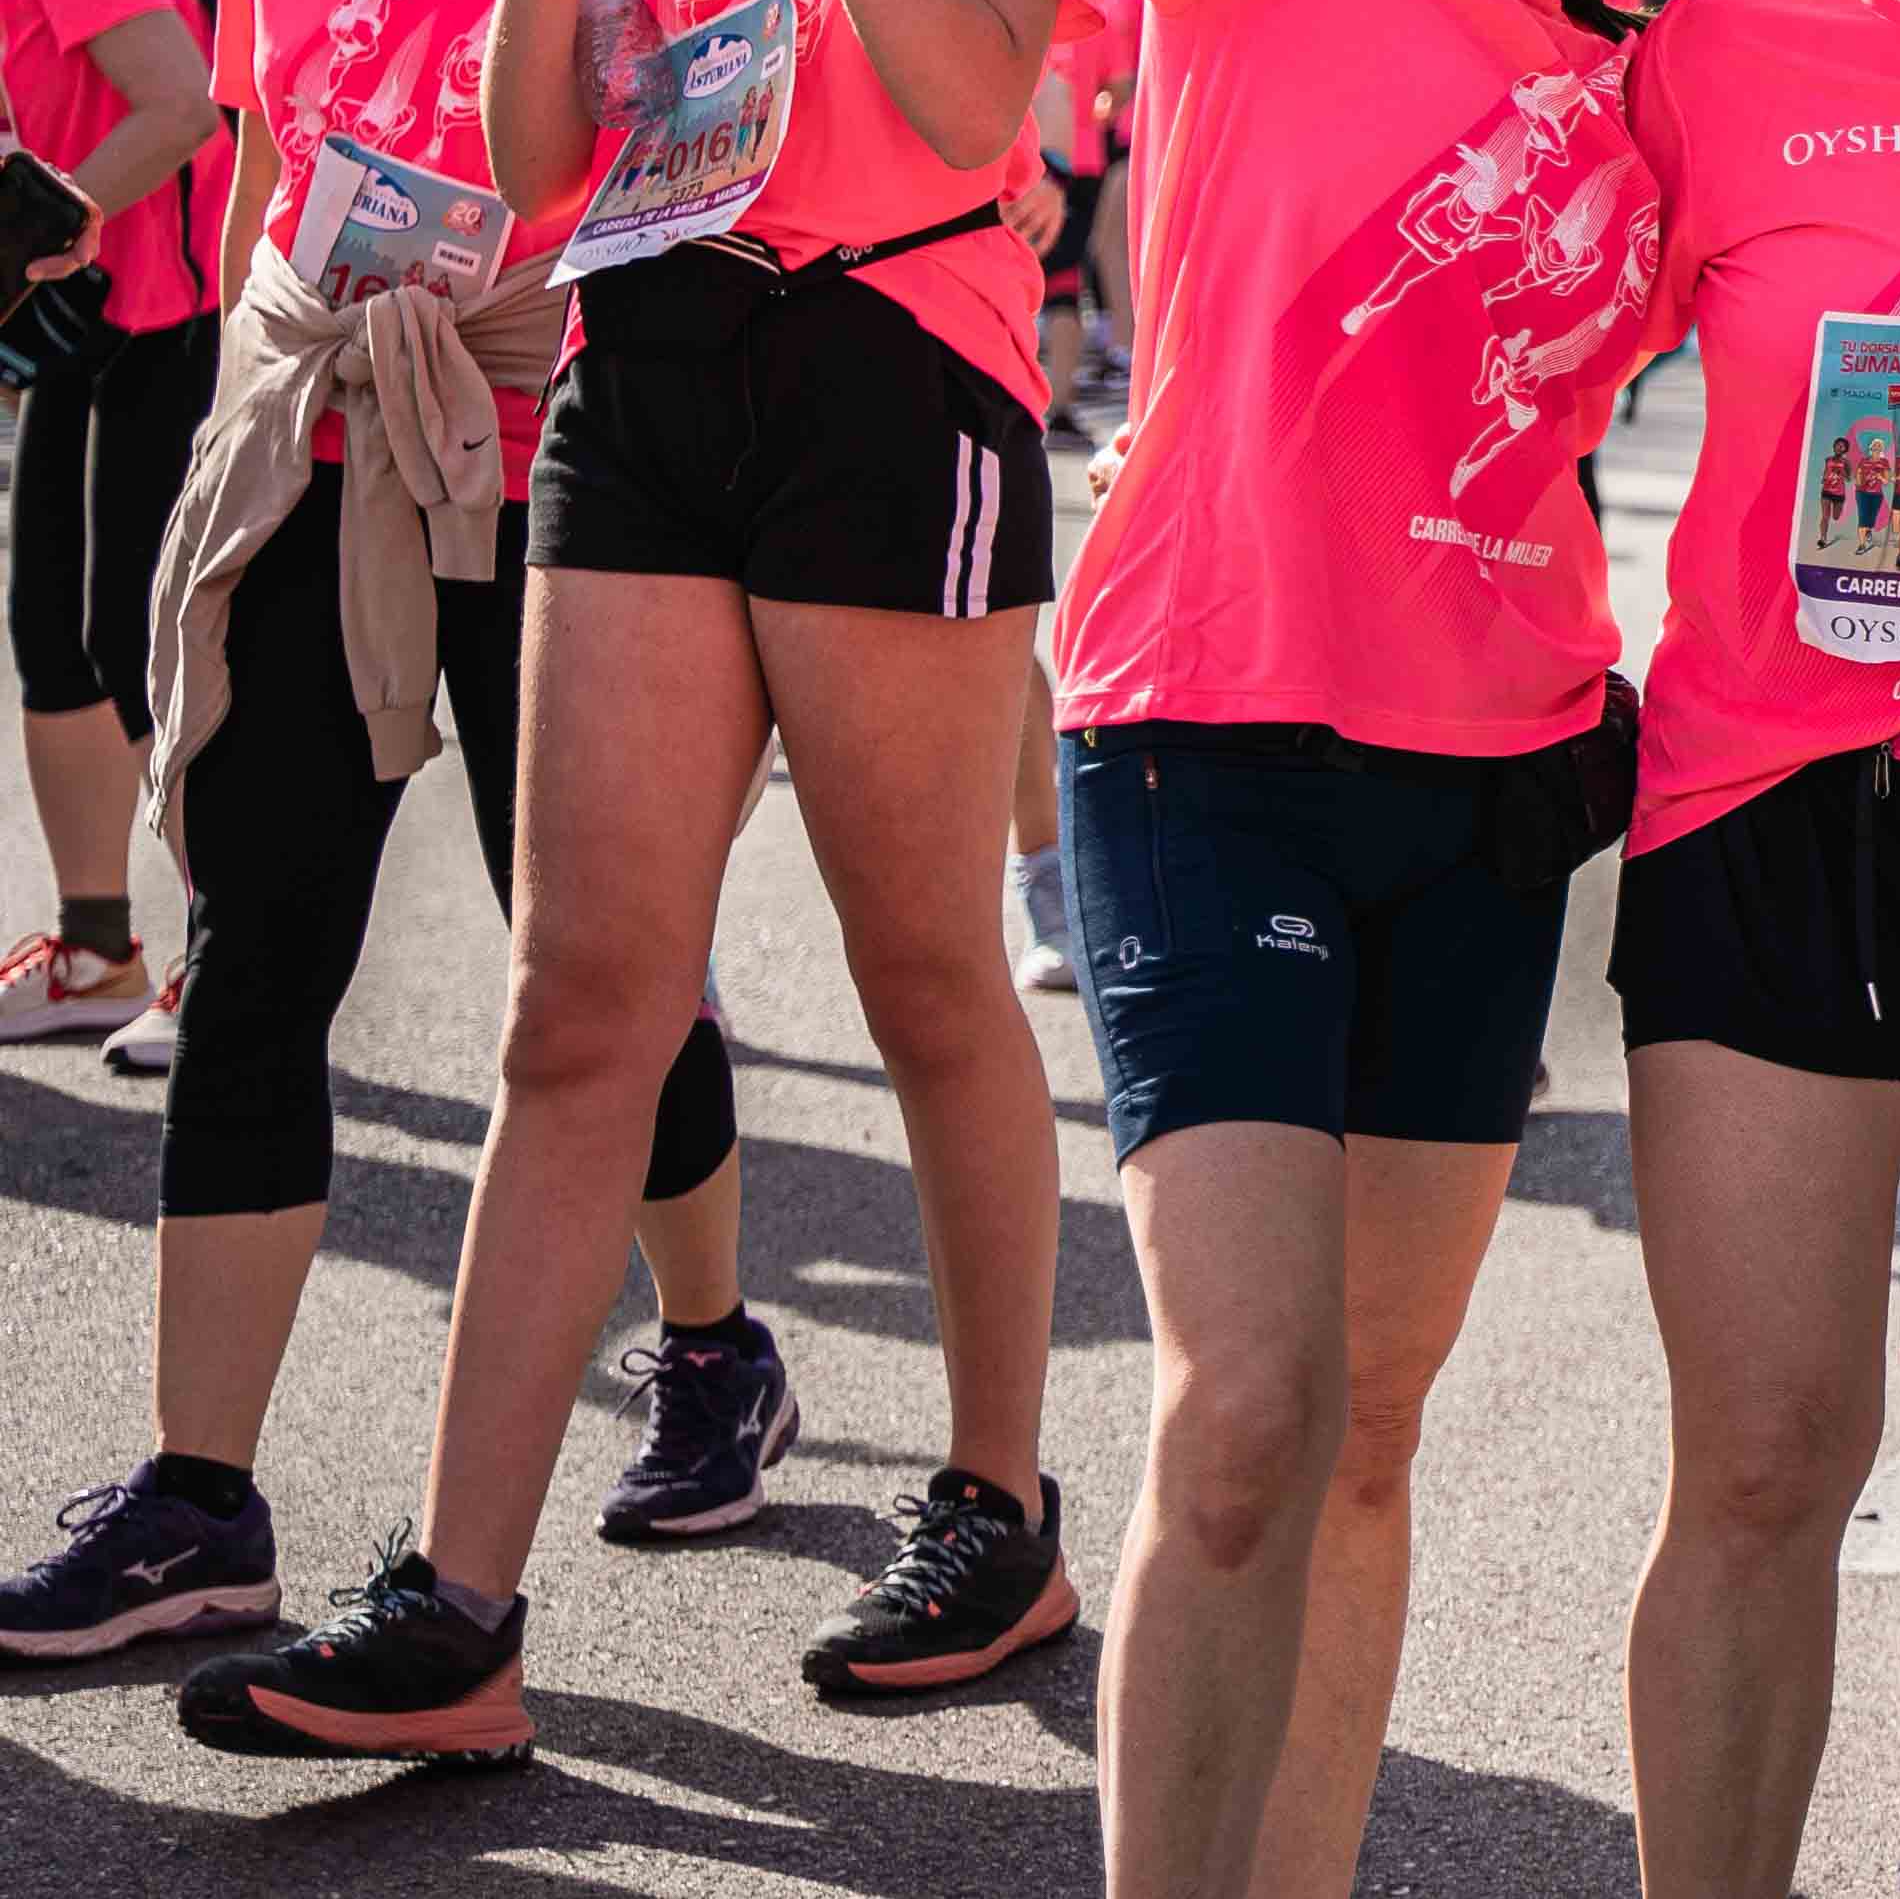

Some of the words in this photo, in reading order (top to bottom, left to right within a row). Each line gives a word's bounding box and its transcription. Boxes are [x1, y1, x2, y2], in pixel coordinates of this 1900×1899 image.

[666, 122, 732, 181] 016
[1482, 535, 1504, 562] LA
[1504, 539, 1553, 568] MUJER
[1256, 934, 1328, 961] Kalenji
